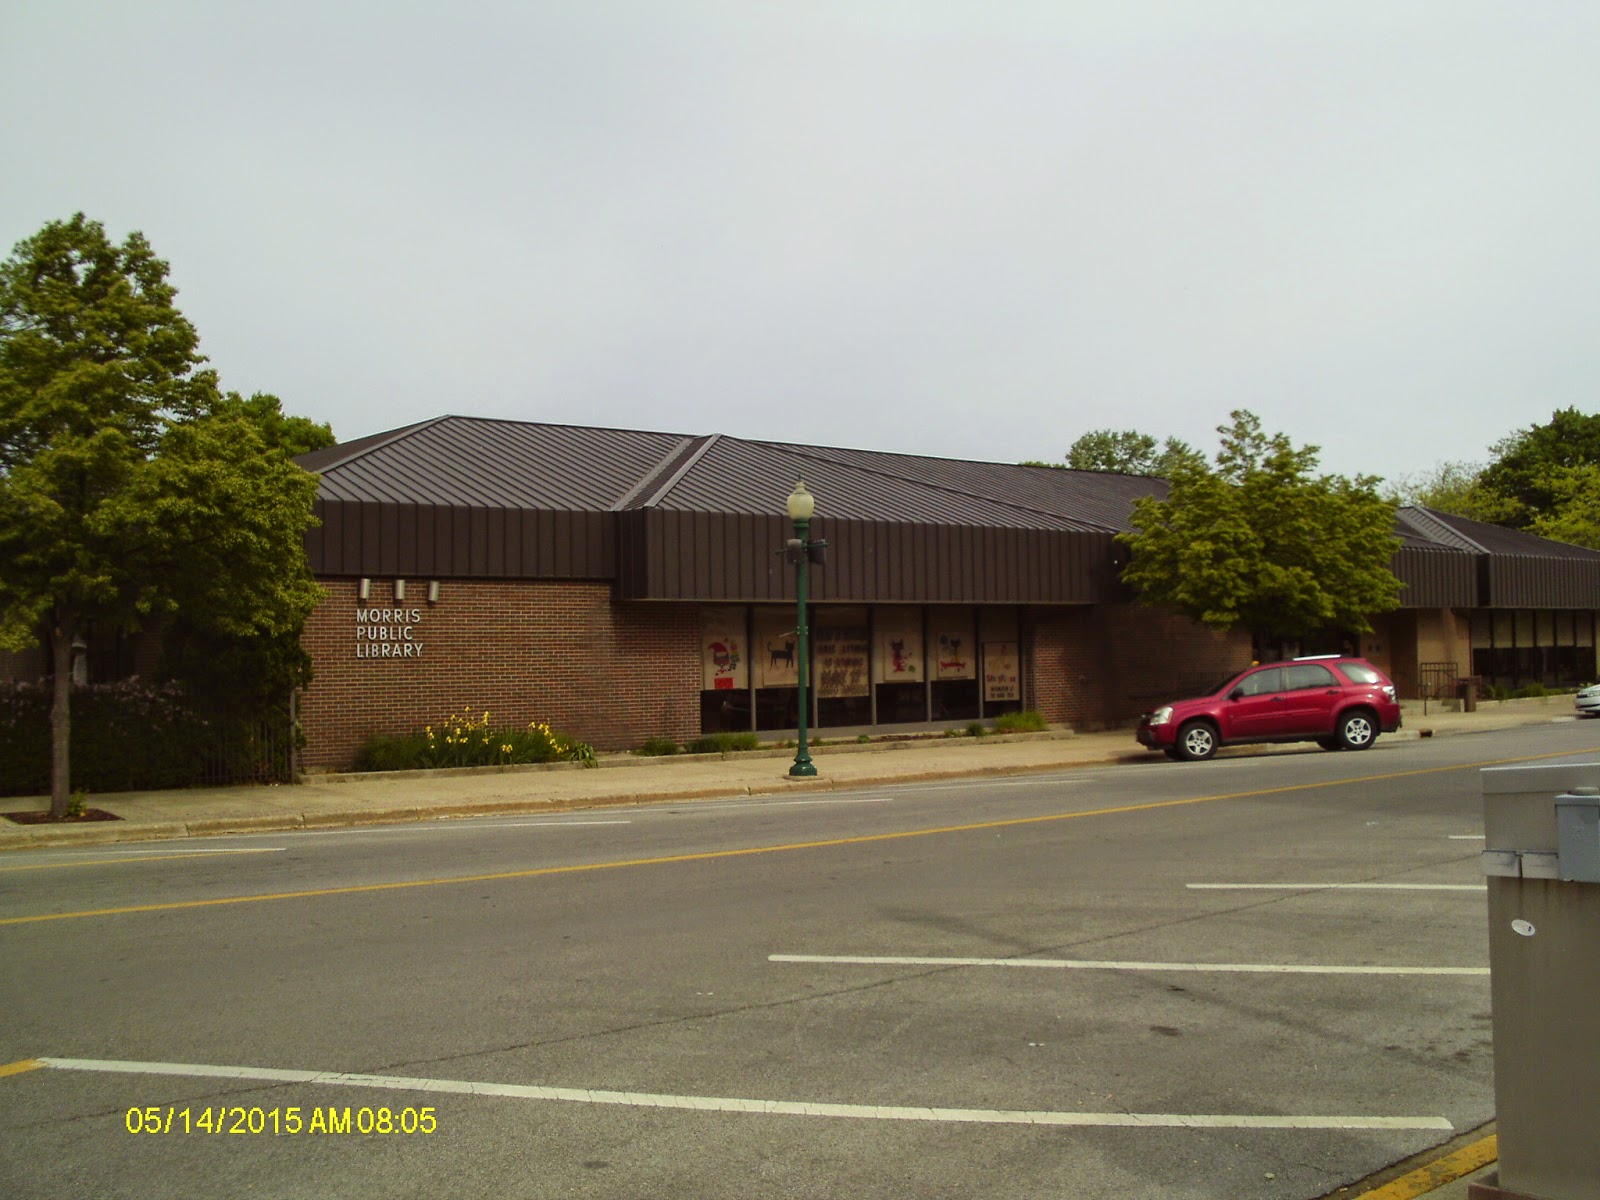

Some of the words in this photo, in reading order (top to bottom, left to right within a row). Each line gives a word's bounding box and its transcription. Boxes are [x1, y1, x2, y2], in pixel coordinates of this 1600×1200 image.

[356, 608, 421, 623] MORRIS
[356, 626, 413, 640] PUBLIC
[356, 643, 423, 658] LIBRARY
